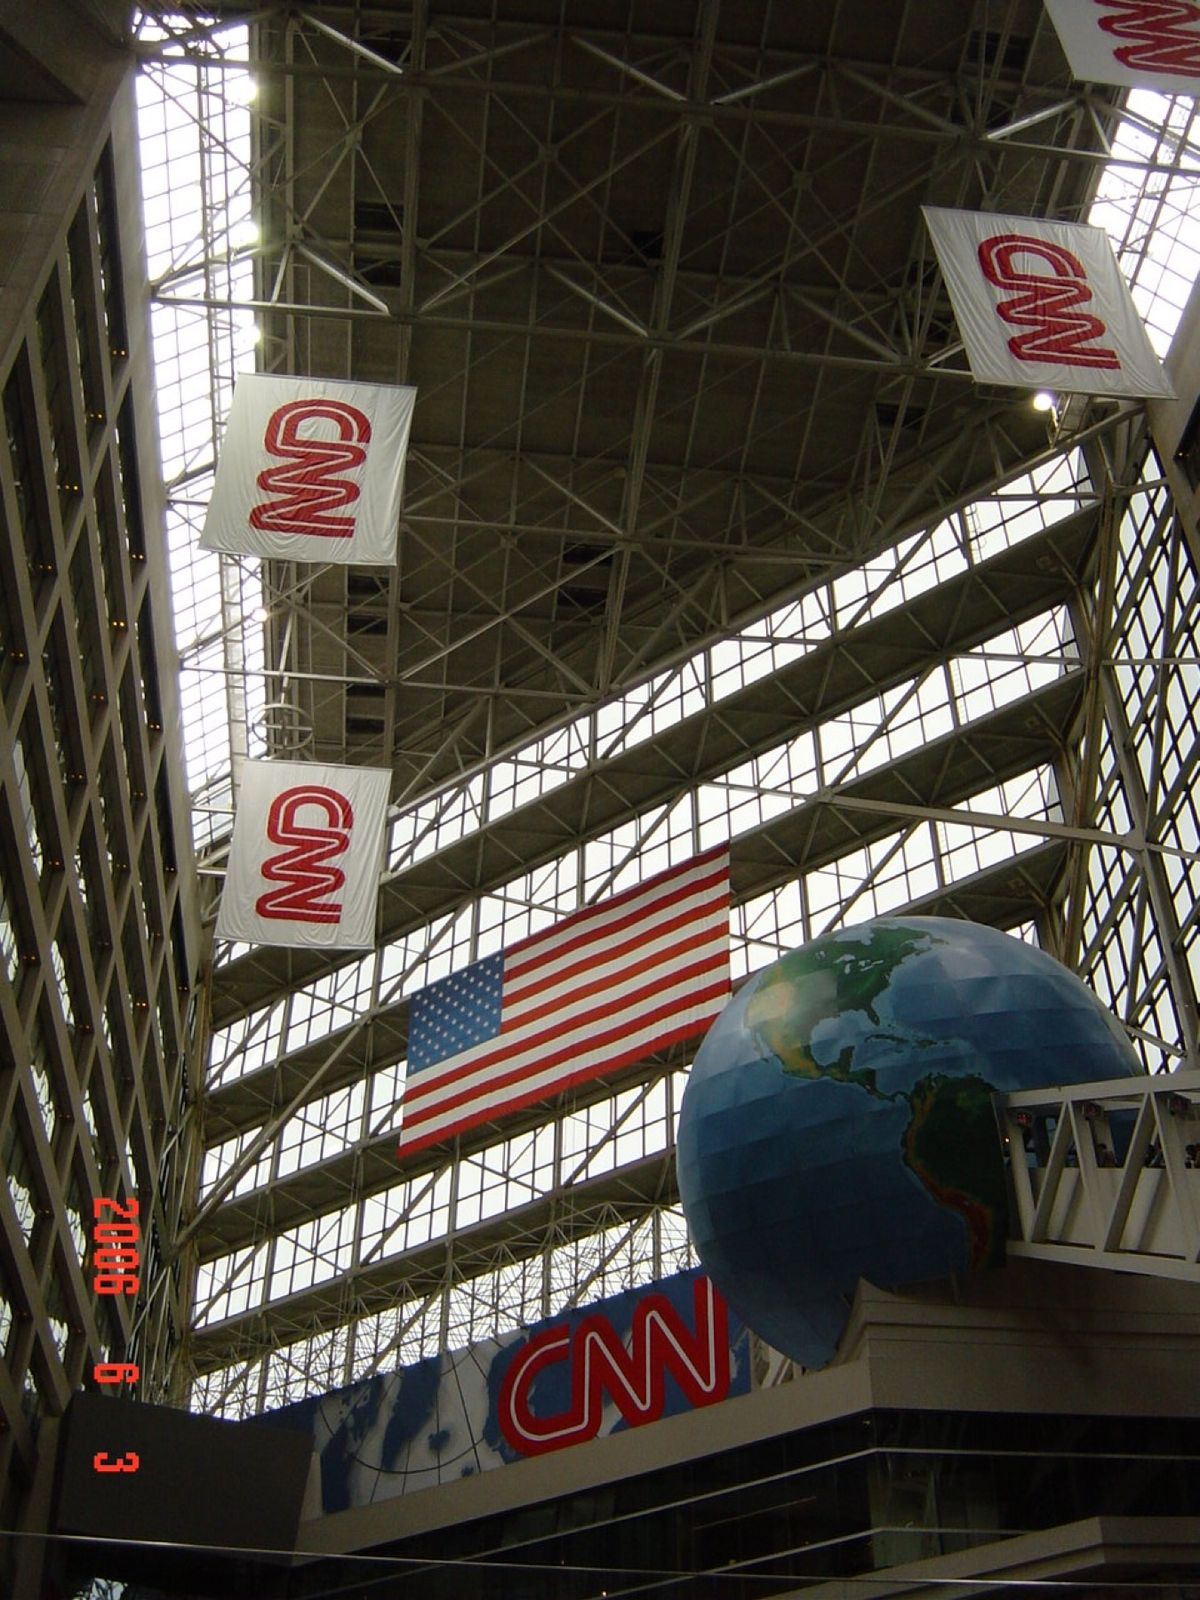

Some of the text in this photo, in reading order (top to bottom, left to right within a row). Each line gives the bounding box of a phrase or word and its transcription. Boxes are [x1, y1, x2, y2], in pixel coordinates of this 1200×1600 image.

[1094, 0, 1200, 78] NN
[978, 234, 1121, 370] CNN
[249, 398, 372, 539] CNN
[255, 784, 354, 925] CNN
[498, 1275, 731, 1458] CNN
